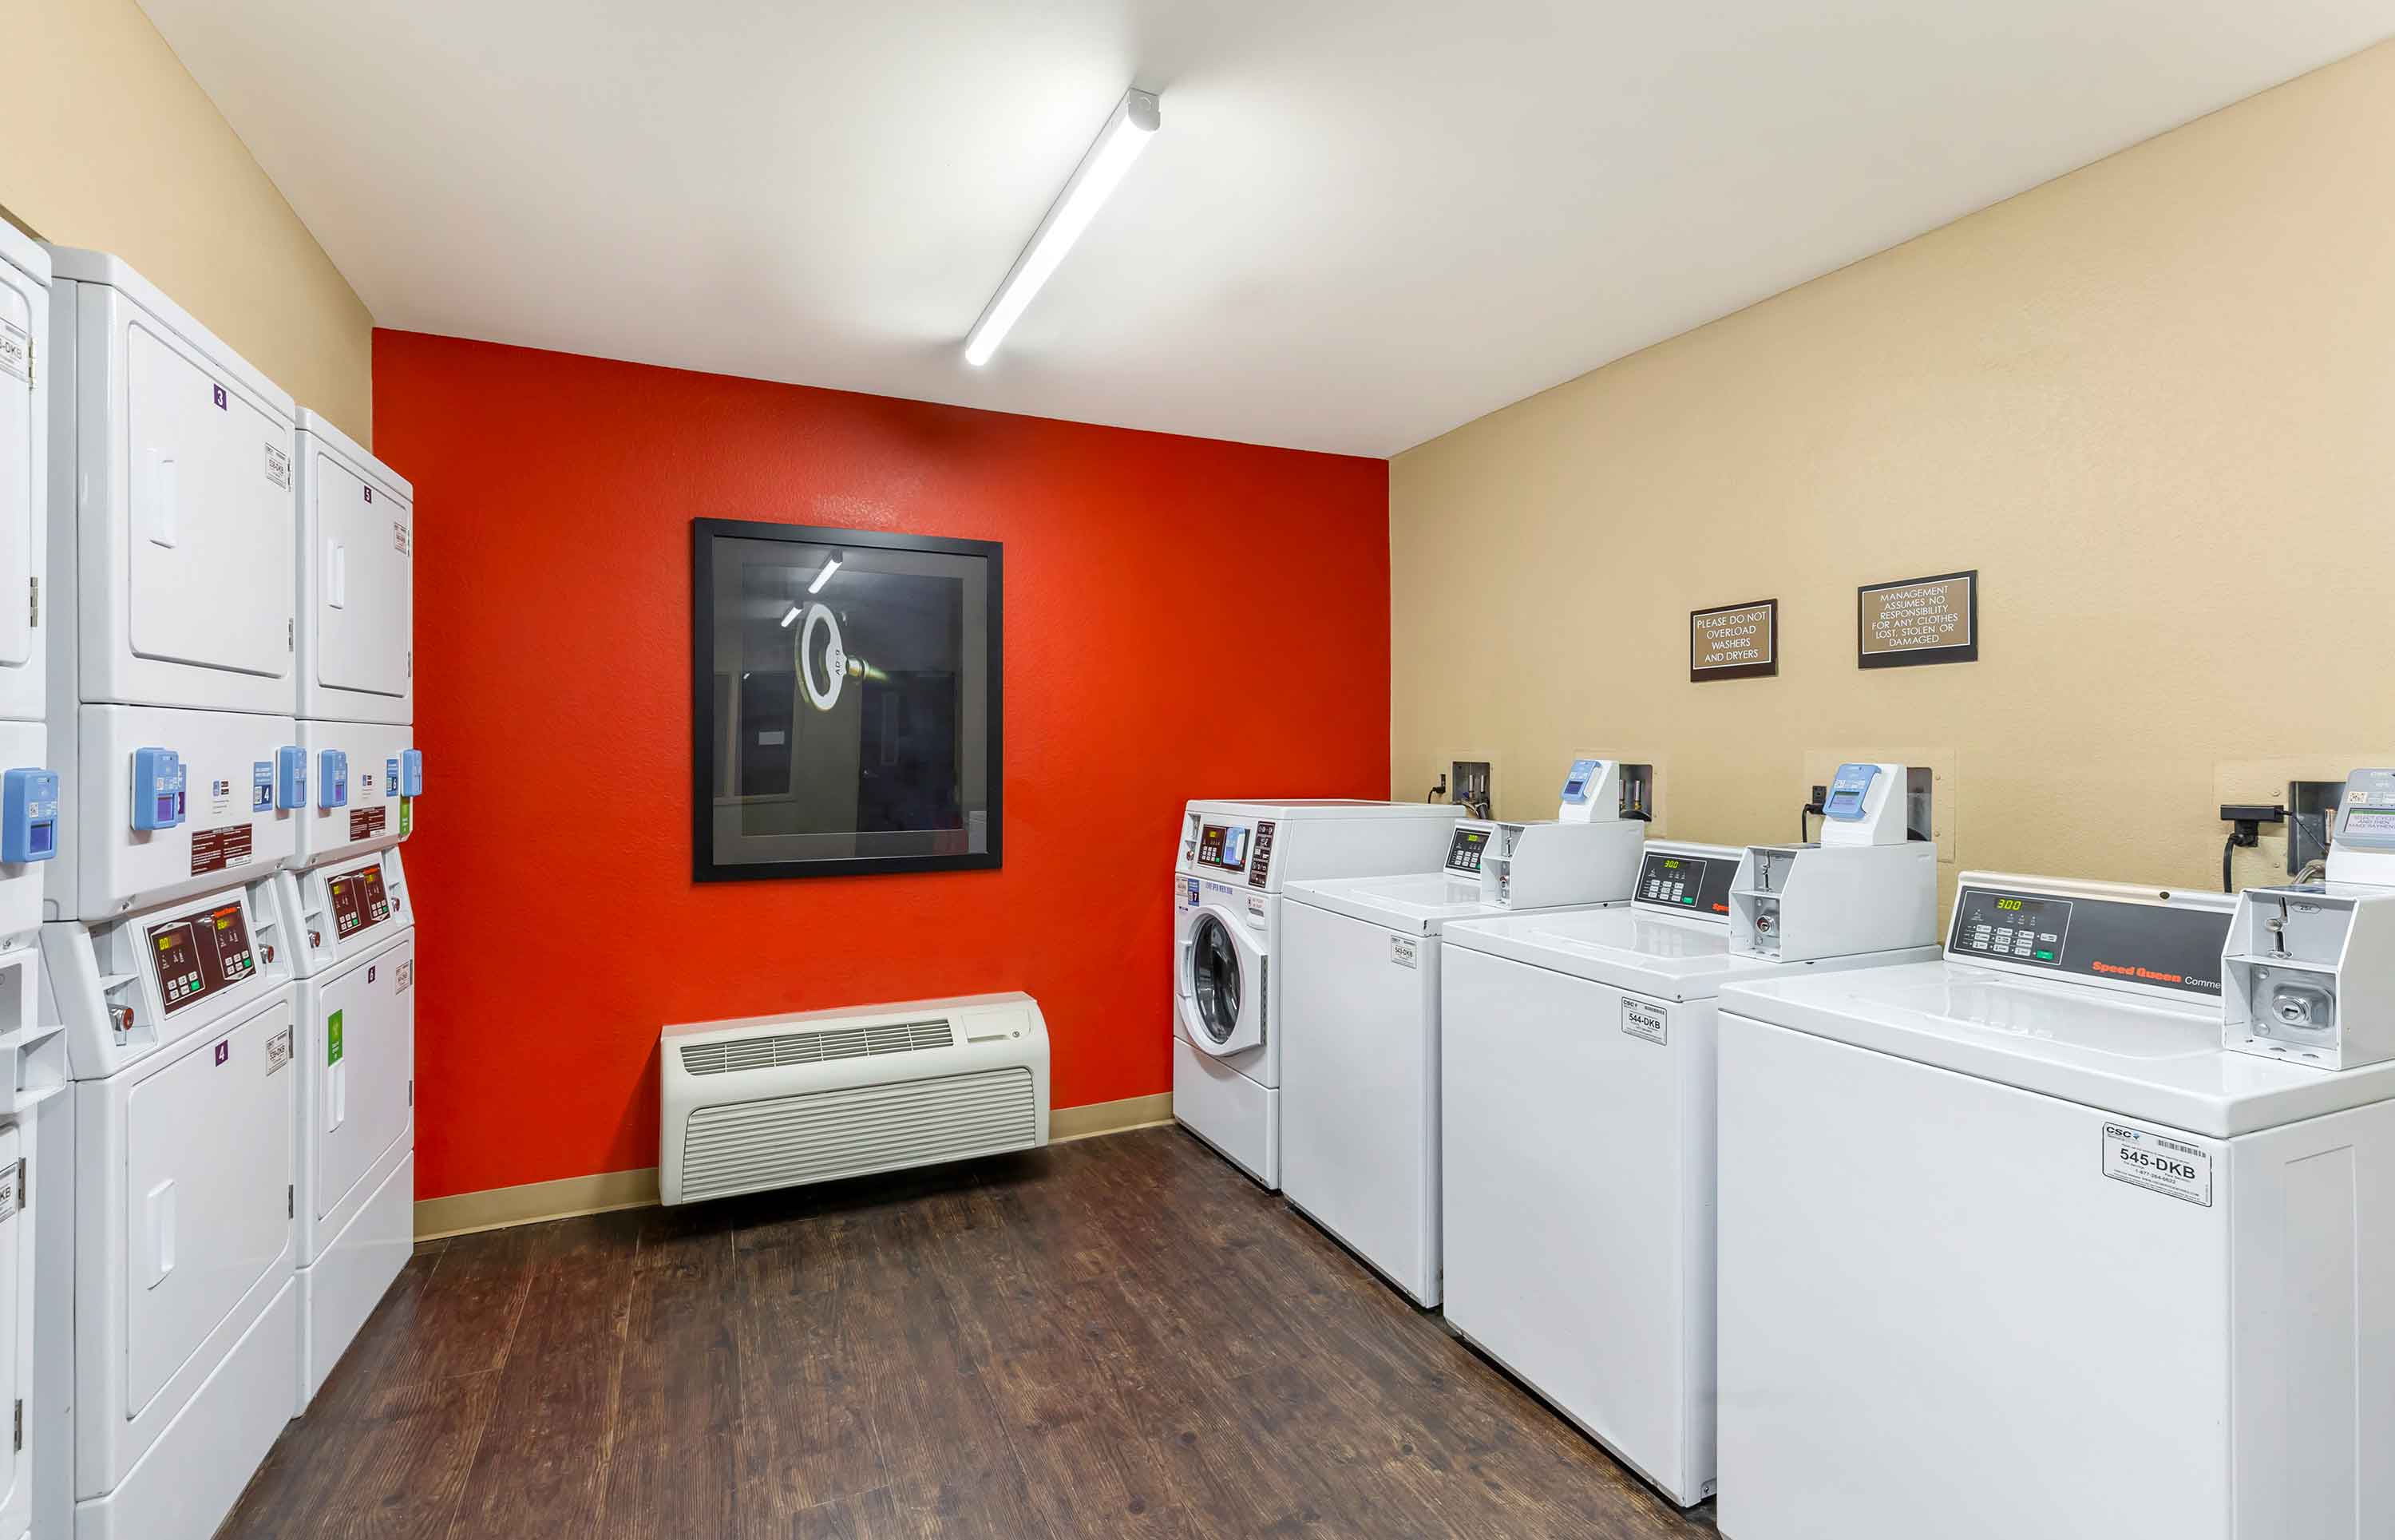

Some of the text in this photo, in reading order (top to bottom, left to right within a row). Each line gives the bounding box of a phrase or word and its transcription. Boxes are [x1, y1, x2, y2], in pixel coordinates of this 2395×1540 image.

[217, 390, 224, 406] 3
[366, 489, 370, 501] 5
[1880, 586, 1948, 601] MANAGEMENT
[1884, 596, 1946, 611] ASSUMES NO
[1880, 605, 1948, 620] RESPONSIBILITY
[1697, 612, 1767, 629] PLEASE DO NOT
[1871, 613, 1959, 631] FOR ANY CLOTHES
[1706, 625, 1756, 639] OVERLOAD
[1902, 626, 1936, 637] STOLEN
[1939, 623, 1954, 632] OR
[1711, 638, 1751, 649] WASHERS
[1889, 635, 1940, 647] DAMAGED
[1704, 649, 1759, 663] AND DRYERS
[264, 787, 270, 802] 4
[1997, 899, 2021, 910] 300
[2092, 961, 2135, 976] Speed
[2136, 968, 2182, 983] Queen
[1629, 1012, 1661, 1029] 544-DKB
[218, 1045, 225, 1061] 4
[2106, 1126, 2132, 1138] CSC
[2120, 1147, 2195, 1180] 545-DKB
